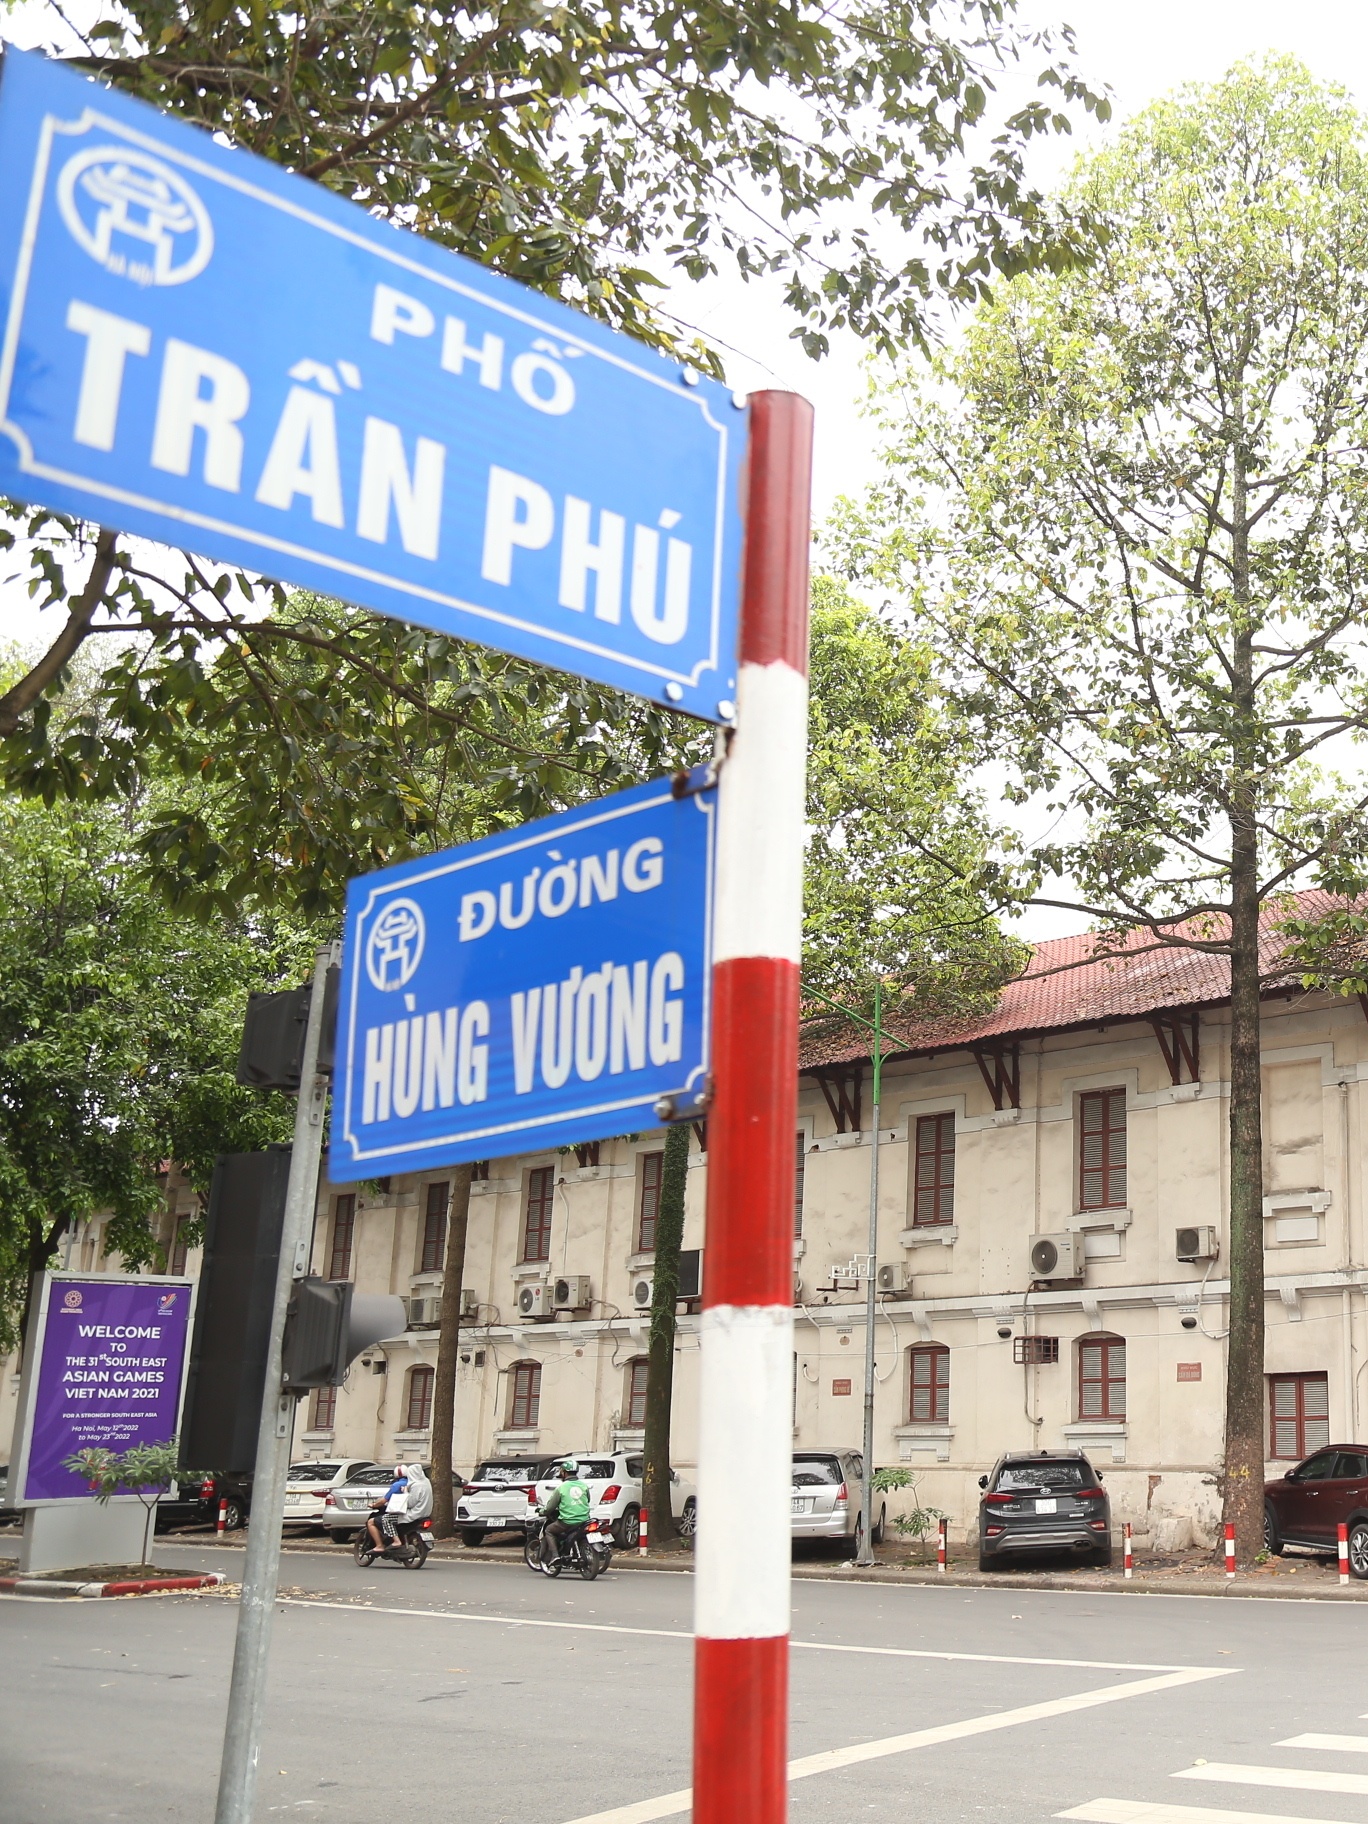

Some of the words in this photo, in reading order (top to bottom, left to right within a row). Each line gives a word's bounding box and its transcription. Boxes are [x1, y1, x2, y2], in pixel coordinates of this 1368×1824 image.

[370, 283, 592, 417] PHỐ
[66, 300, 448, 562] TRẦN
[481, 464, 694, 646] PHÚ
[458, 836, 665, 943] ĐƯỜNG
[362, 992, 491, 1126] HÙNG
[510, 951, 686, 1096] VƯƠNG
[79, 1325, 161, 1338] WELCOME
[110, 1343, 126, 1352] TO
[66, 1356, 86, 1366] THE
[106, 1357, 139, 1367] SOUTH
[142, 1358, 167, 1367] EAST
[63, 1371, 109, 1382] ASIAN
[113, 1372, 164, 1382] GAMES
[65, 1388, 96, 1399] VIET
[98, 1388, 129, 1398] NAM
[132, 1388, 160, 1398] 2021
